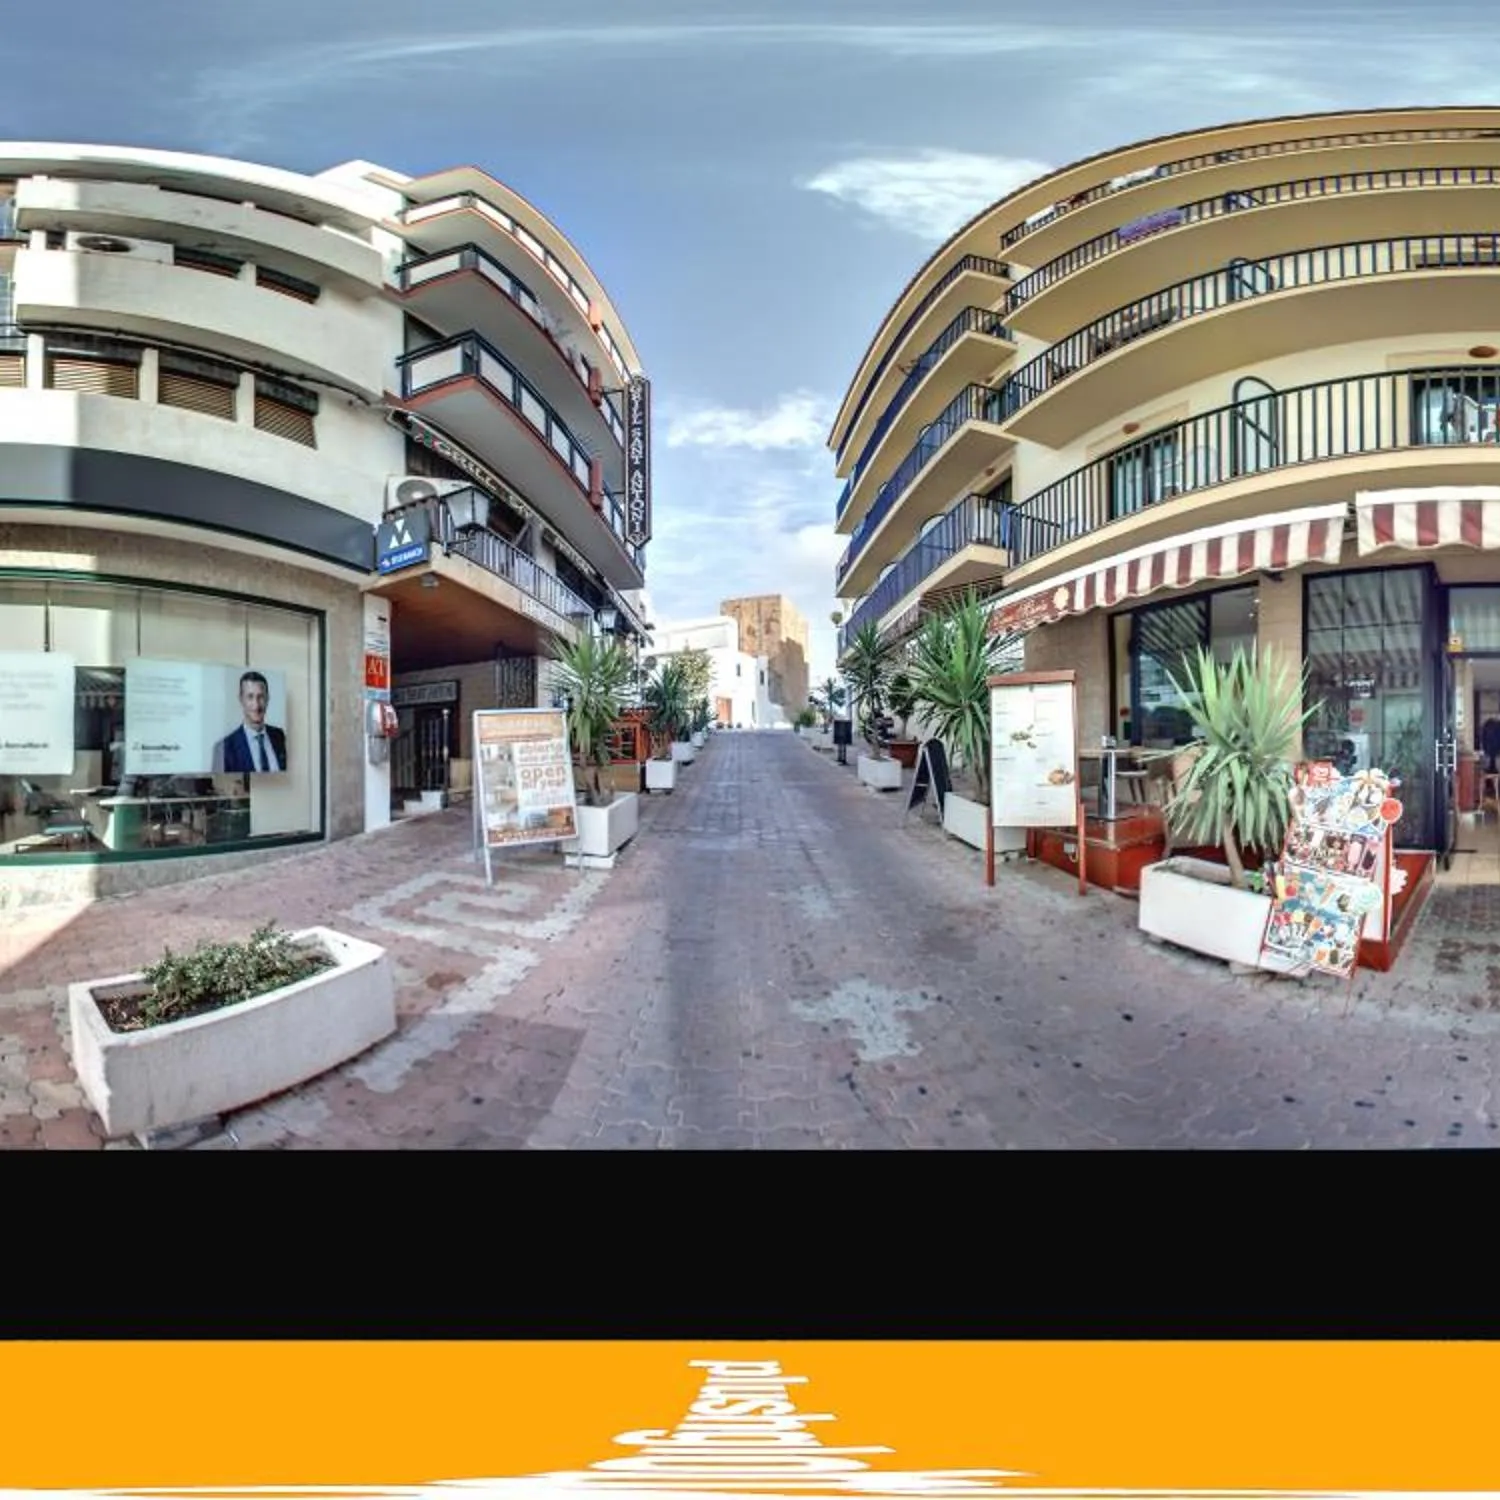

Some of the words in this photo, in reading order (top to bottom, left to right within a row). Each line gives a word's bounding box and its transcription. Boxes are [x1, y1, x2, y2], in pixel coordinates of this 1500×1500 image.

[631, 428, 644, 465] SANT
[631, 469, 645, 533] ANTONI
[520, 766, 567, 783] open
